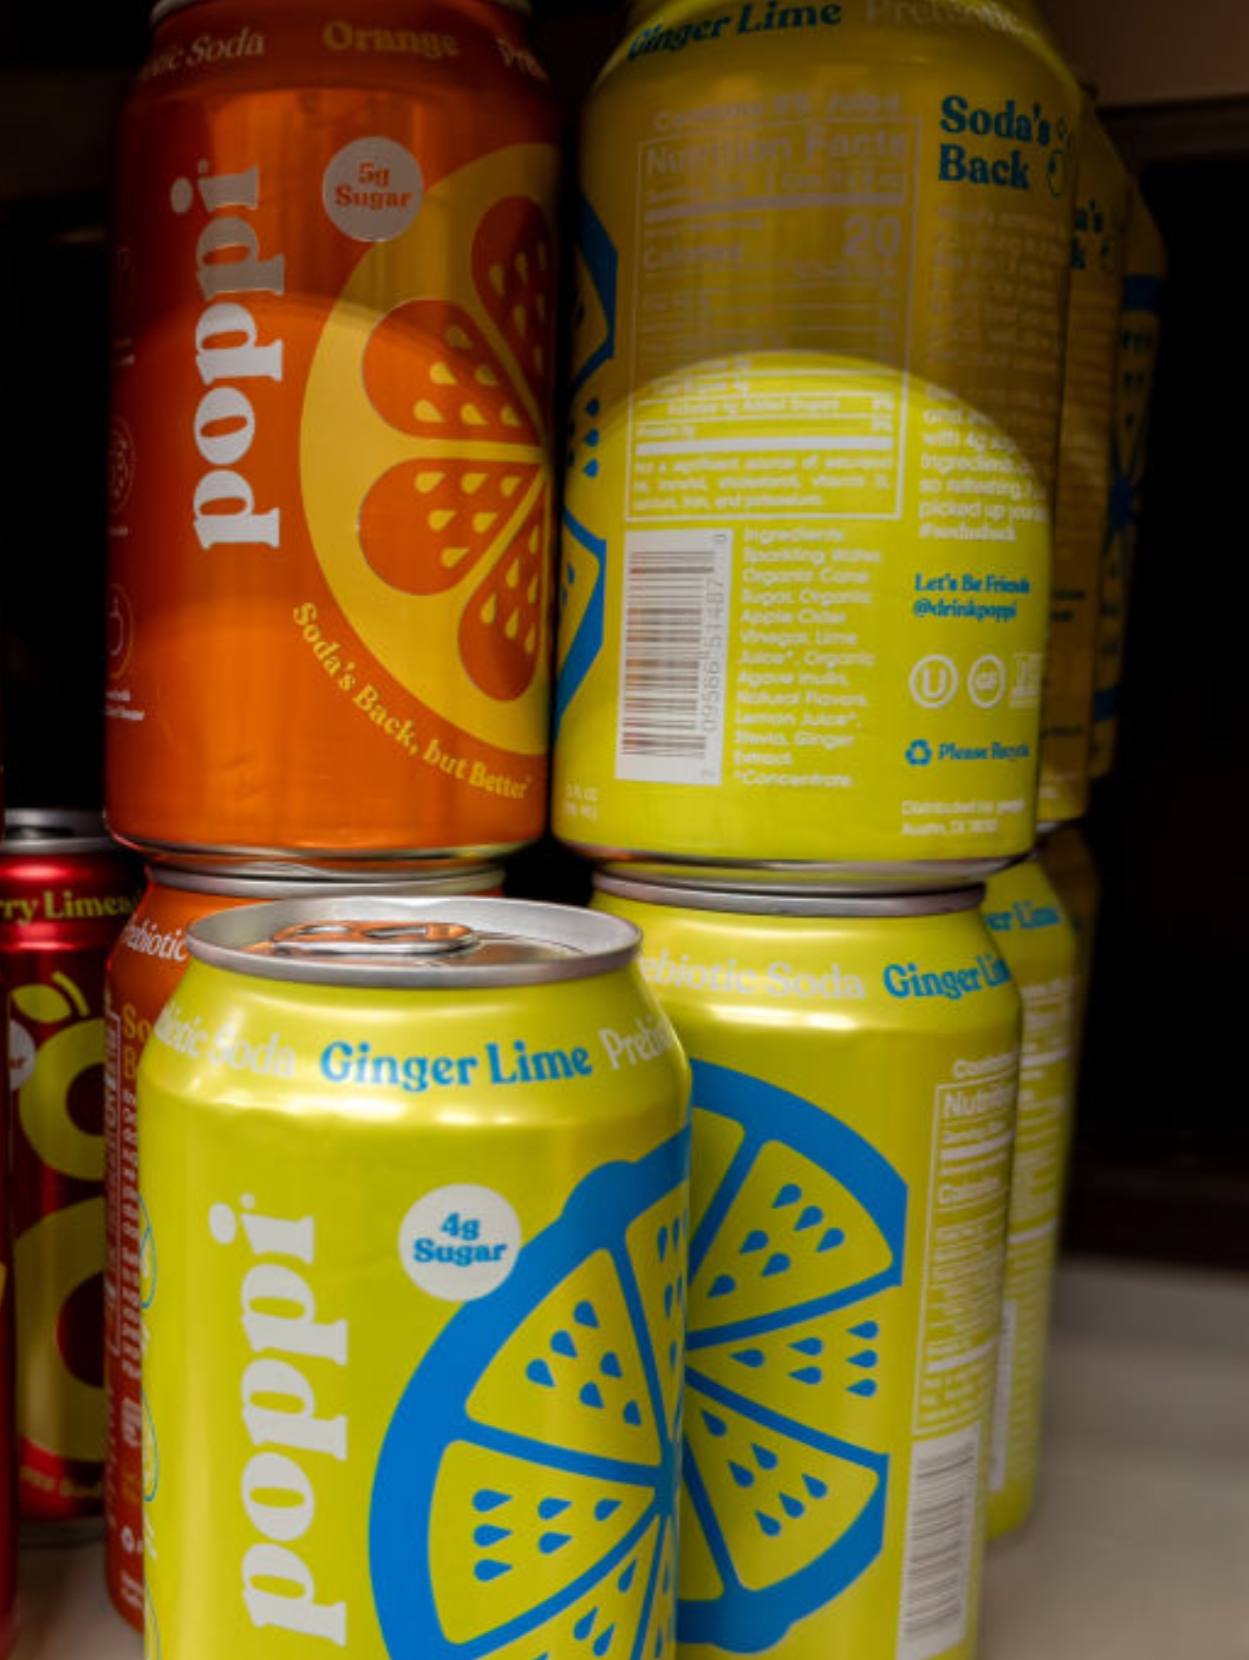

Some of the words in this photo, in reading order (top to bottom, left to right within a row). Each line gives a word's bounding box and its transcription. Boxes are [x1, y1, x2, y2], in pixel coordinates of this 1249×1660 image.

[737, 1, 842, 34] Lime
[186, 27, 266, 67] Soda
[323, 20, 460, 59] Orange
[940, 94, 1051, 146] Soda's
[647, 131, 792, 176] Nutrition
[805, 127, 907, 165] Facts
[938, 143, 1029, 190] Back
[358, 161, 390, 190] 5g
[335, 184, 412, 211] Sugar
[841, 214, 903, 258] 20
[170, 161, 285, 551] poppi
[742, 568, 813, 586] Organic
[820, 568, 869, 584] Cane
[915, 573, 957, 591] Let's
[961, 573, 983, 592] Be
[741, 609, 794, 626] Apple
[913, 598, 1018, 623] @drinkpoppi
[293, 602, 356, 692] Soda's
[352, 684, 421, 757] Back,
[423, 738, 467, 781] but
[468, 761, 530, 800] Better
[735, 711, 795, 727] Lemon
[640, 949, 757, 995] ebiotic
[763, 960, 867, 999] Soda
[883, 962, 981, 1001] Ginger
[207, 1024, 296, 1080] Soda
[319, 1040, 478, 1092] Ginger
[485, 1039, 593, 1085] Lime
[440, 1212, 480, 1243] 4g
[412, 1237, 508, 1267] Sugar
[208, 1200, 349, 1648] poppi
